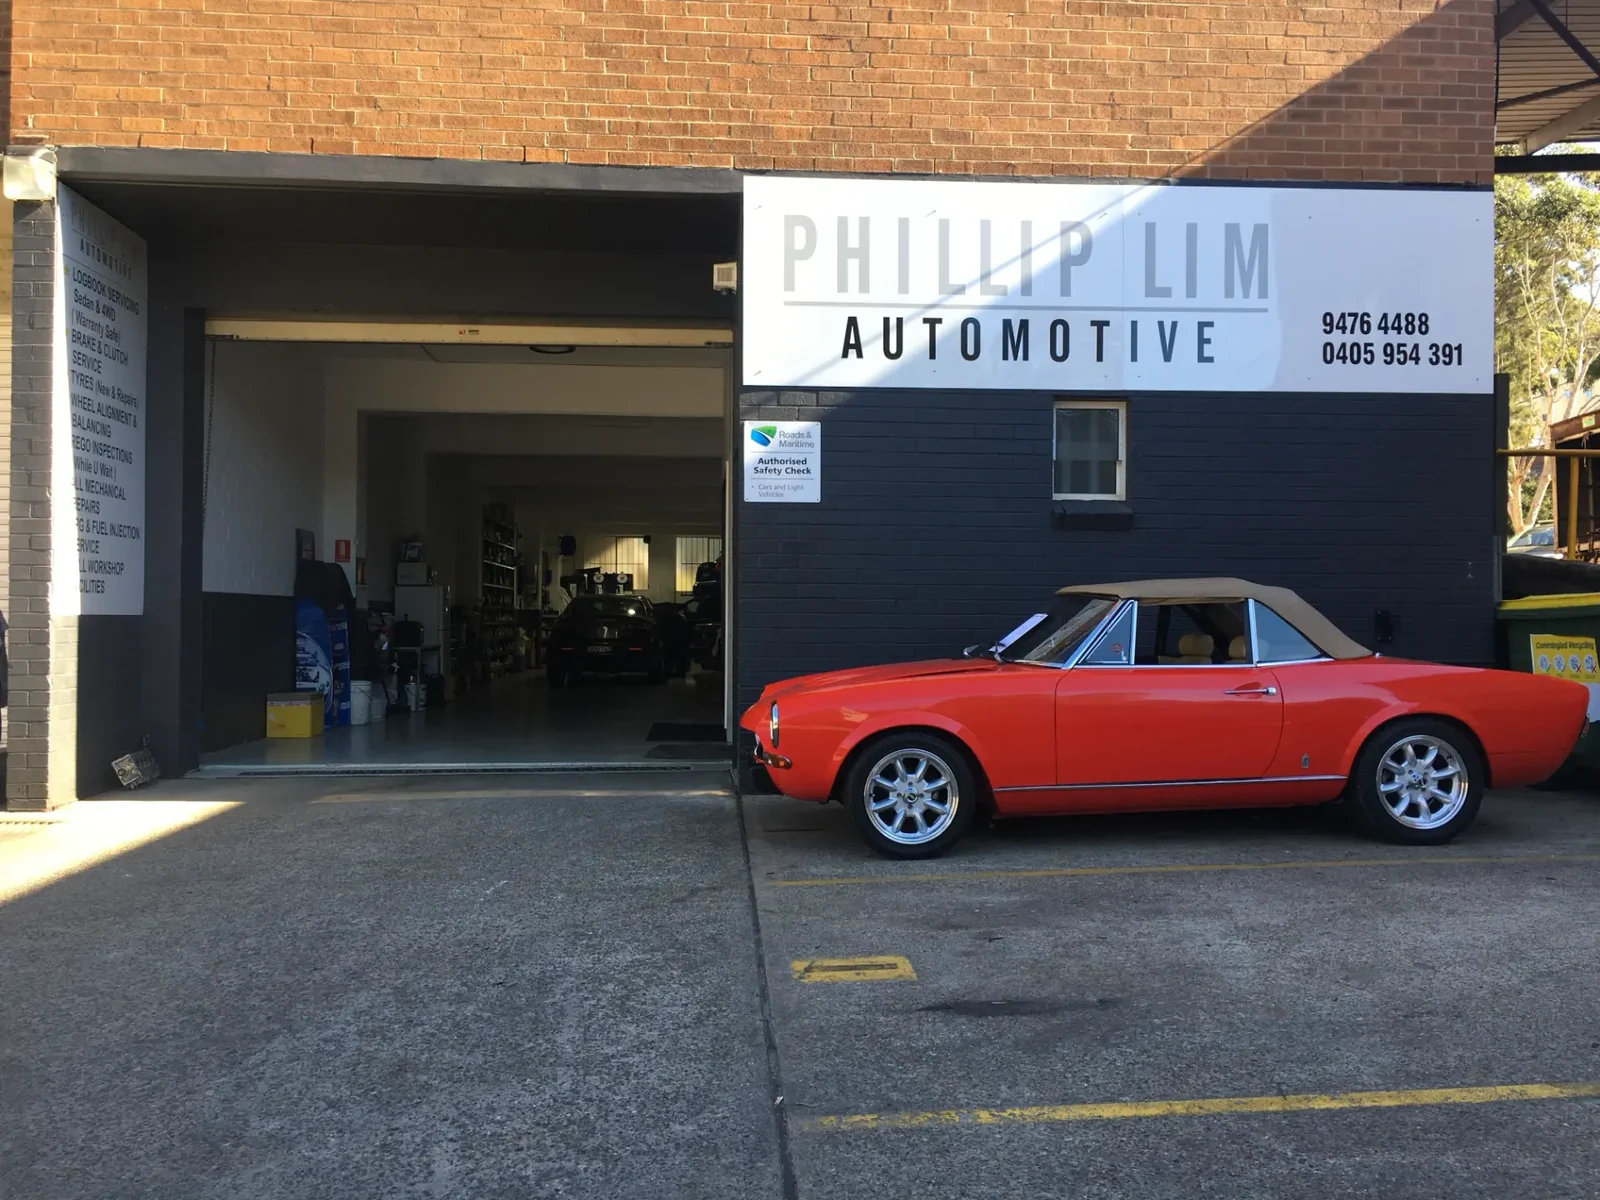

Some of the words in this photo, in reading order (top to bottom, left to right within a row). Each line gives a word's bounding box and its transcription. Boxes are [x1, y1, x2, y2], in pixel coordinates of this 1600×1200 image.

[80, 238, 132, 281] AUTOMOTIVE
[784, 214, 1093, 298] PHILLIP
[1144, 221, 1269, 300] LIM
[72, 266, 107, 298] LOGBOOK
[107, 286, 140, 315] SERVICING
[74, 288, 95, 311] Sedan
[95, 300, 101, 314] &
[102, 304, 116, 322] 4WD
[1322, 311, 1371, 335] 9476
[1377, 312, 1430, 336] 4488
[71, 328, 96, 352] BRAKE
[97, 340, 103, 355] &
[103, 343, 129, 366] CLUTCH
[841, 315, 1215, 364] AUTOMOTIVE
[72, 349, 102, 375] SERVICE
[1322, 341, 1375, 365] 0405
[1382, 342, 1421, 366] 954
[1428, 342, 1464, 366] 391
[71, 369, 94, 391] TYRES
[111, 385, 116, 400] &
[71, 392, 95, 414] WHEEL
[97, 401, 132, 428] ALIGNMENT
[132, 414, 138, 429] &
[72, 412, 112, 438] BALANCING
[779, 430, 805, 439] Roads
[805, 430, 812, 439] &
[71, 433, 91, 453] REGO
[92, 439, 133, 465] INSPECTIONS
[779, 440, 815, 448] Maritime
[94, 460, 99, 475] U
[753, 466, 783, 477] Safety
[784, 466, 812, 475] Check
[757, 457, 808, 466] Authorised
[85, 478, 127, 501] MECHANICAL
[787, 484, 804, 492] Light
[85, 518, 91, 534] &
[92, 519, 109, 537] FUEL
[109, 522, 141, 541] INJECTION
[76, 537, 100, 554] ERVICE
[88, 559, 125, 576] WORKSHOP
[79, 578, 106, 594] CILITIES
[1568, 641, 1595, 650] Recycling
